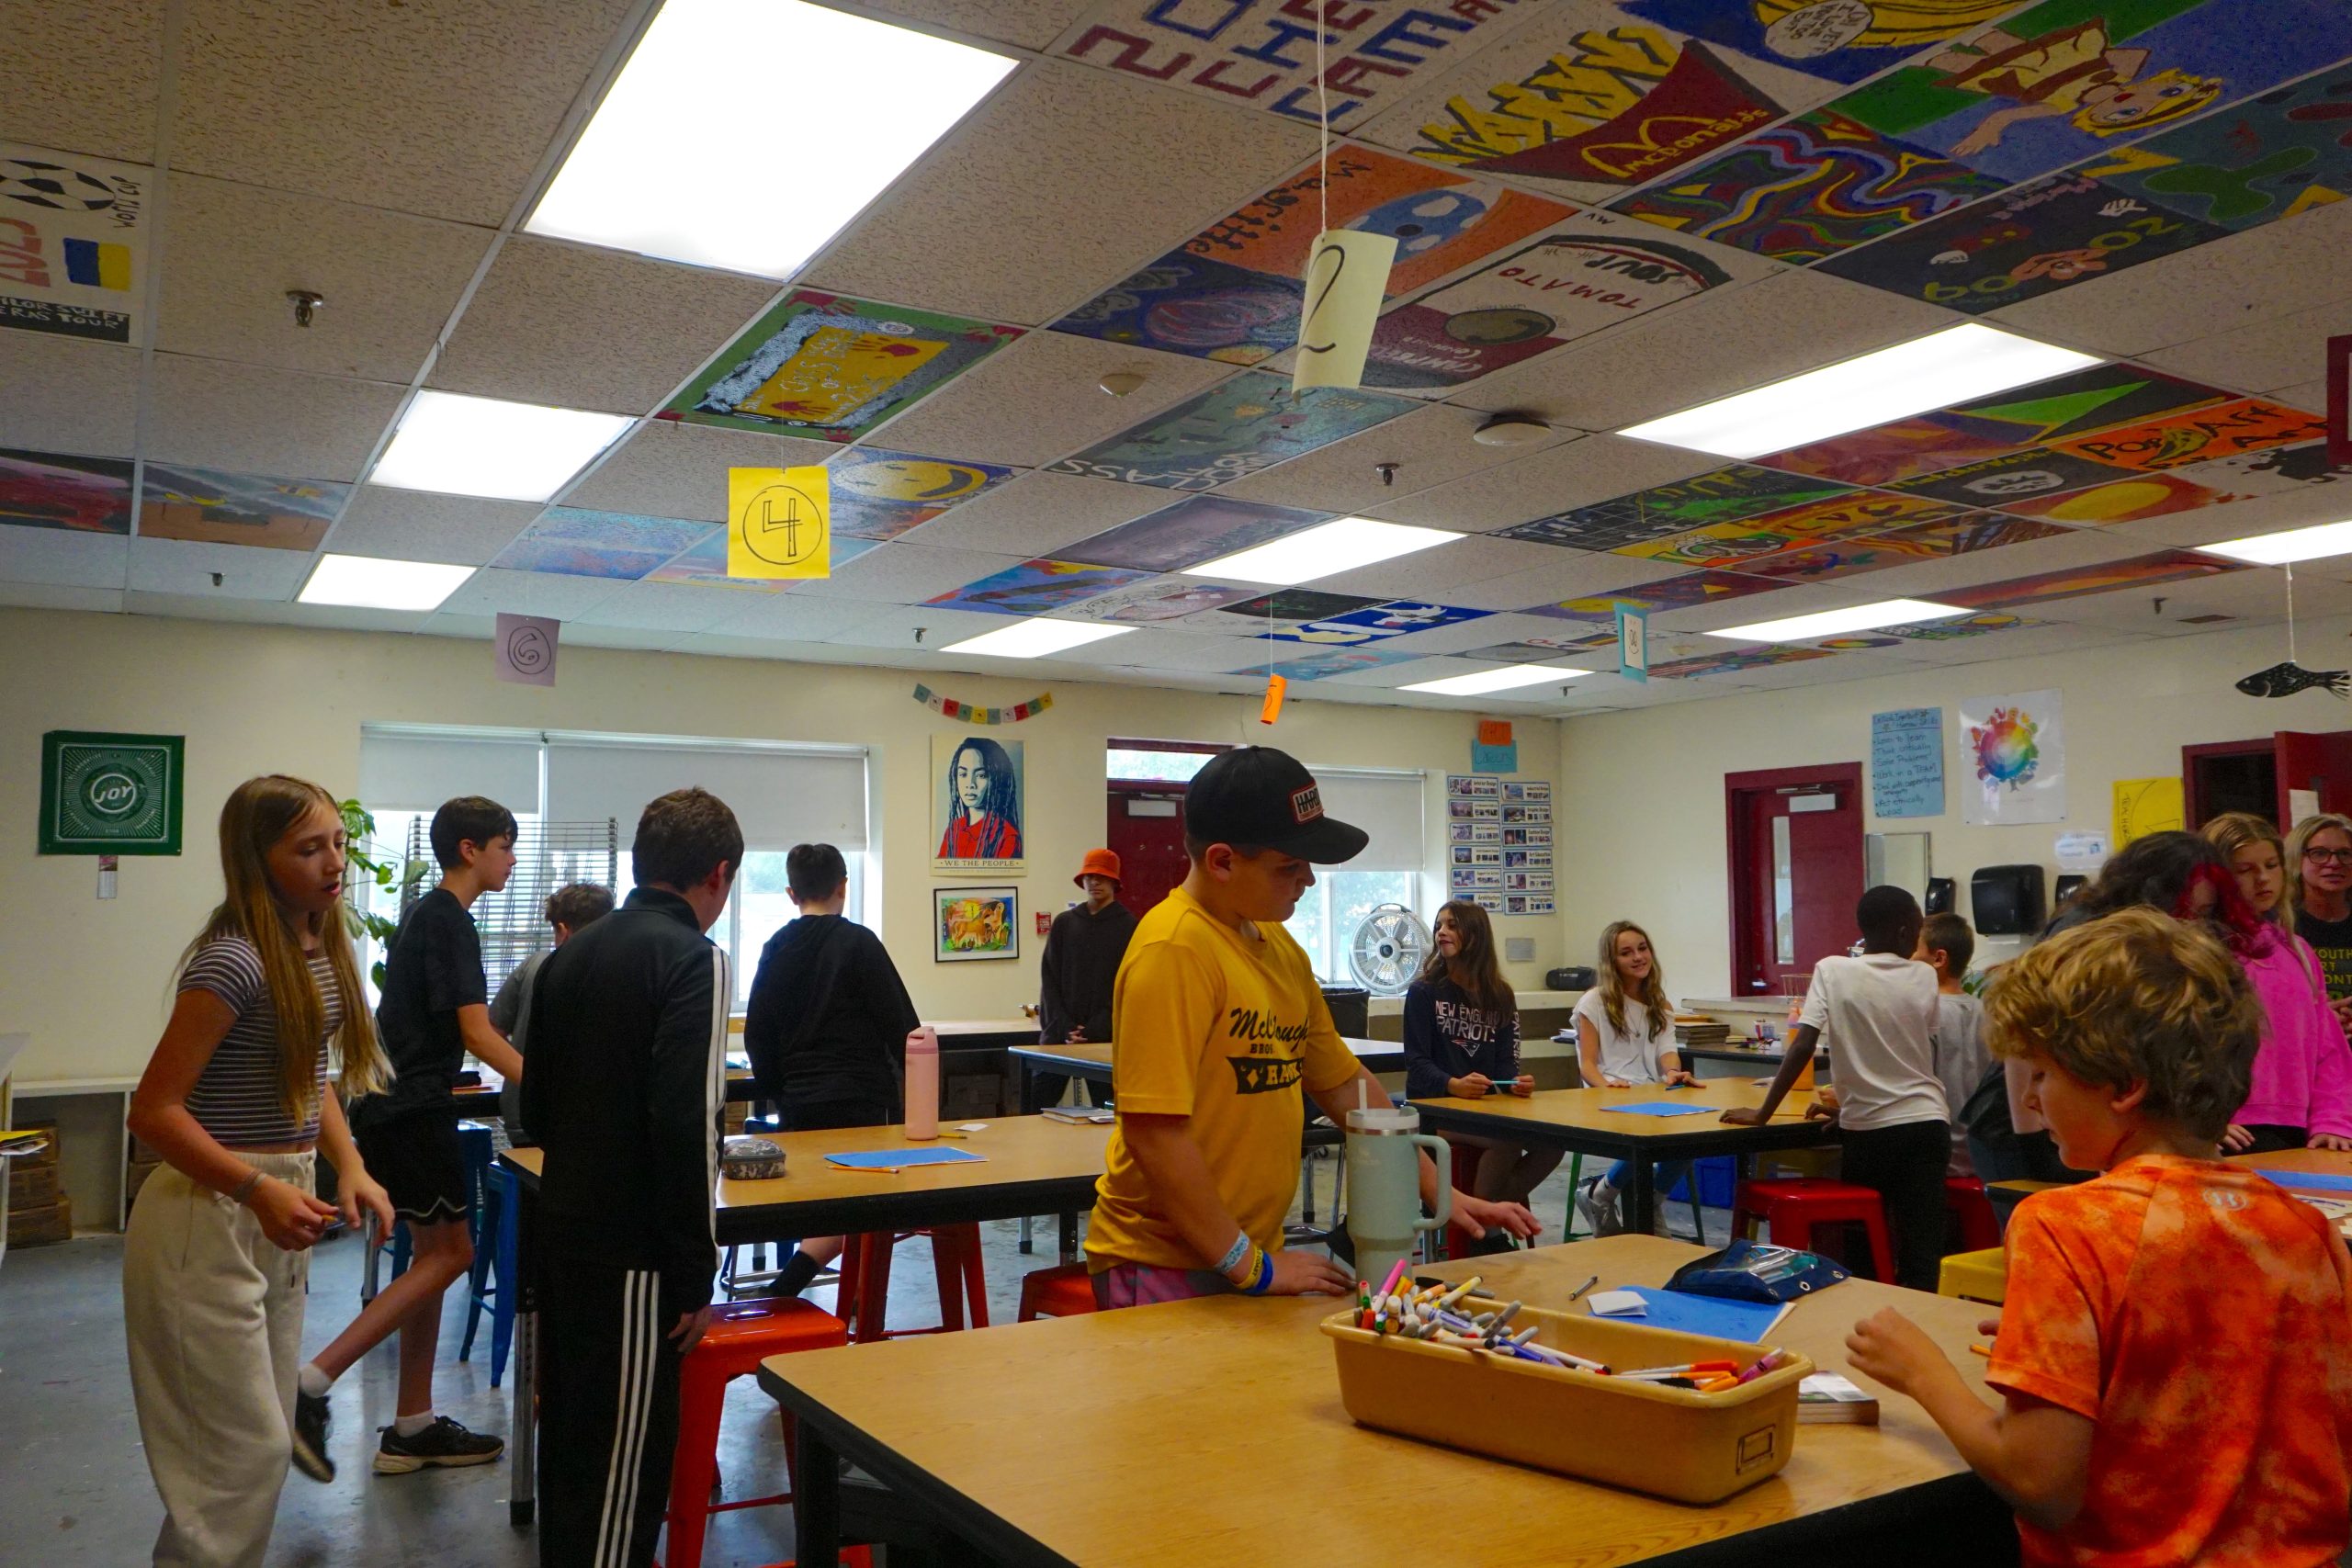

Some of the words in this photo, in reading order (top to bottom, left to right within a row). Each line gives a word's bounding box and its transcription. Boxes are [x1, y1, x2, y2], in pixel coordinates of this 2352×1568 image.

[1583, 254, 1687, 285] SOUP
[1498, 266, 1643, 310] TOMATO
[1053, 458, 1219, 492] CLASS
[1168, 468, 1246, 480] OF
[763, 497, 802, 558] 4
[513, 632, 540, 666] 6
[94, 785, 133, 804] JOY
[1435, 999, 1456, 1019] NEW
